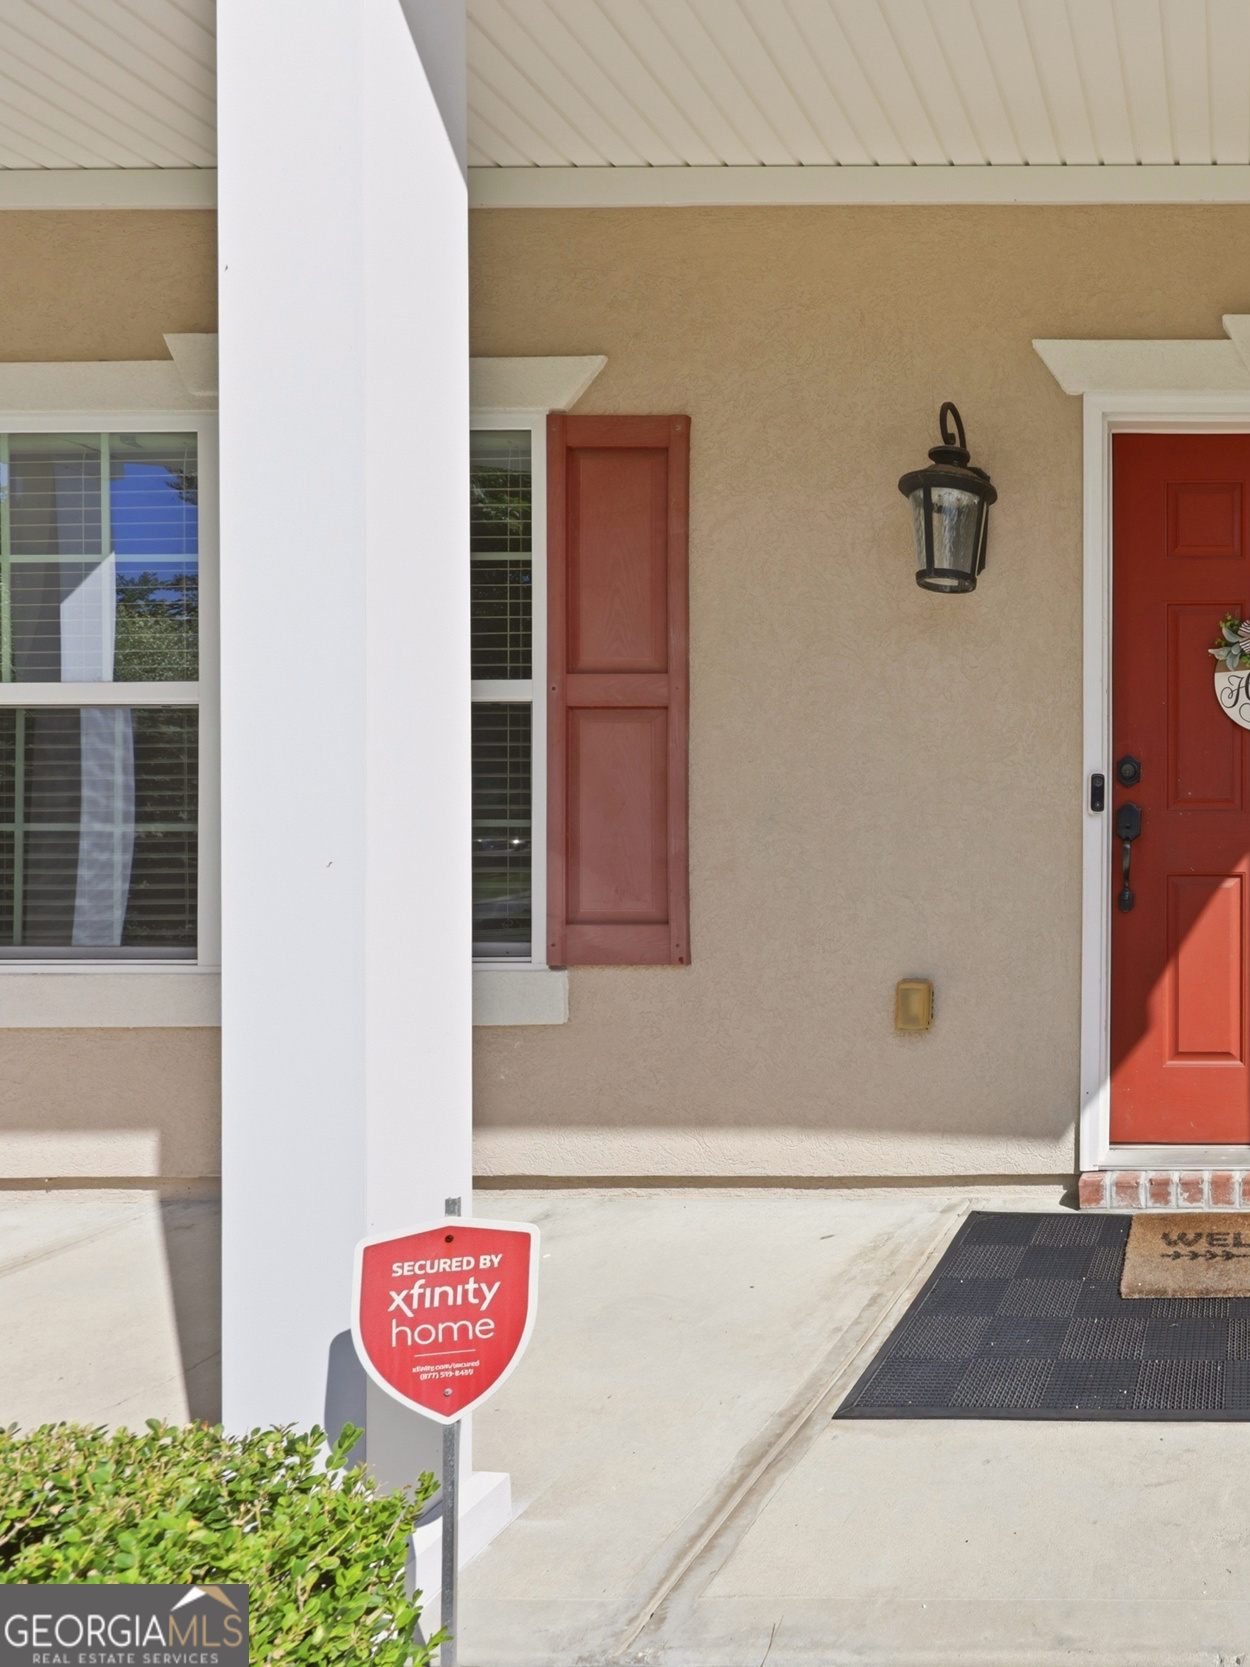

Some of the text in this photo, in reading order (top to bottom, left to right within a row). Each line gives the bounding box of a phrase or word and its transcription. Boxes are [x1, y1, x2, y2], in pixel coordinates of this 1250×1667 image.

[391, 1253, 503, 1277] SECURED BY
[388, 1277, 501, 1317] xfinity
[391, 1318, 495, 1347] home
[419, 1372, 439, 1381] (877)
